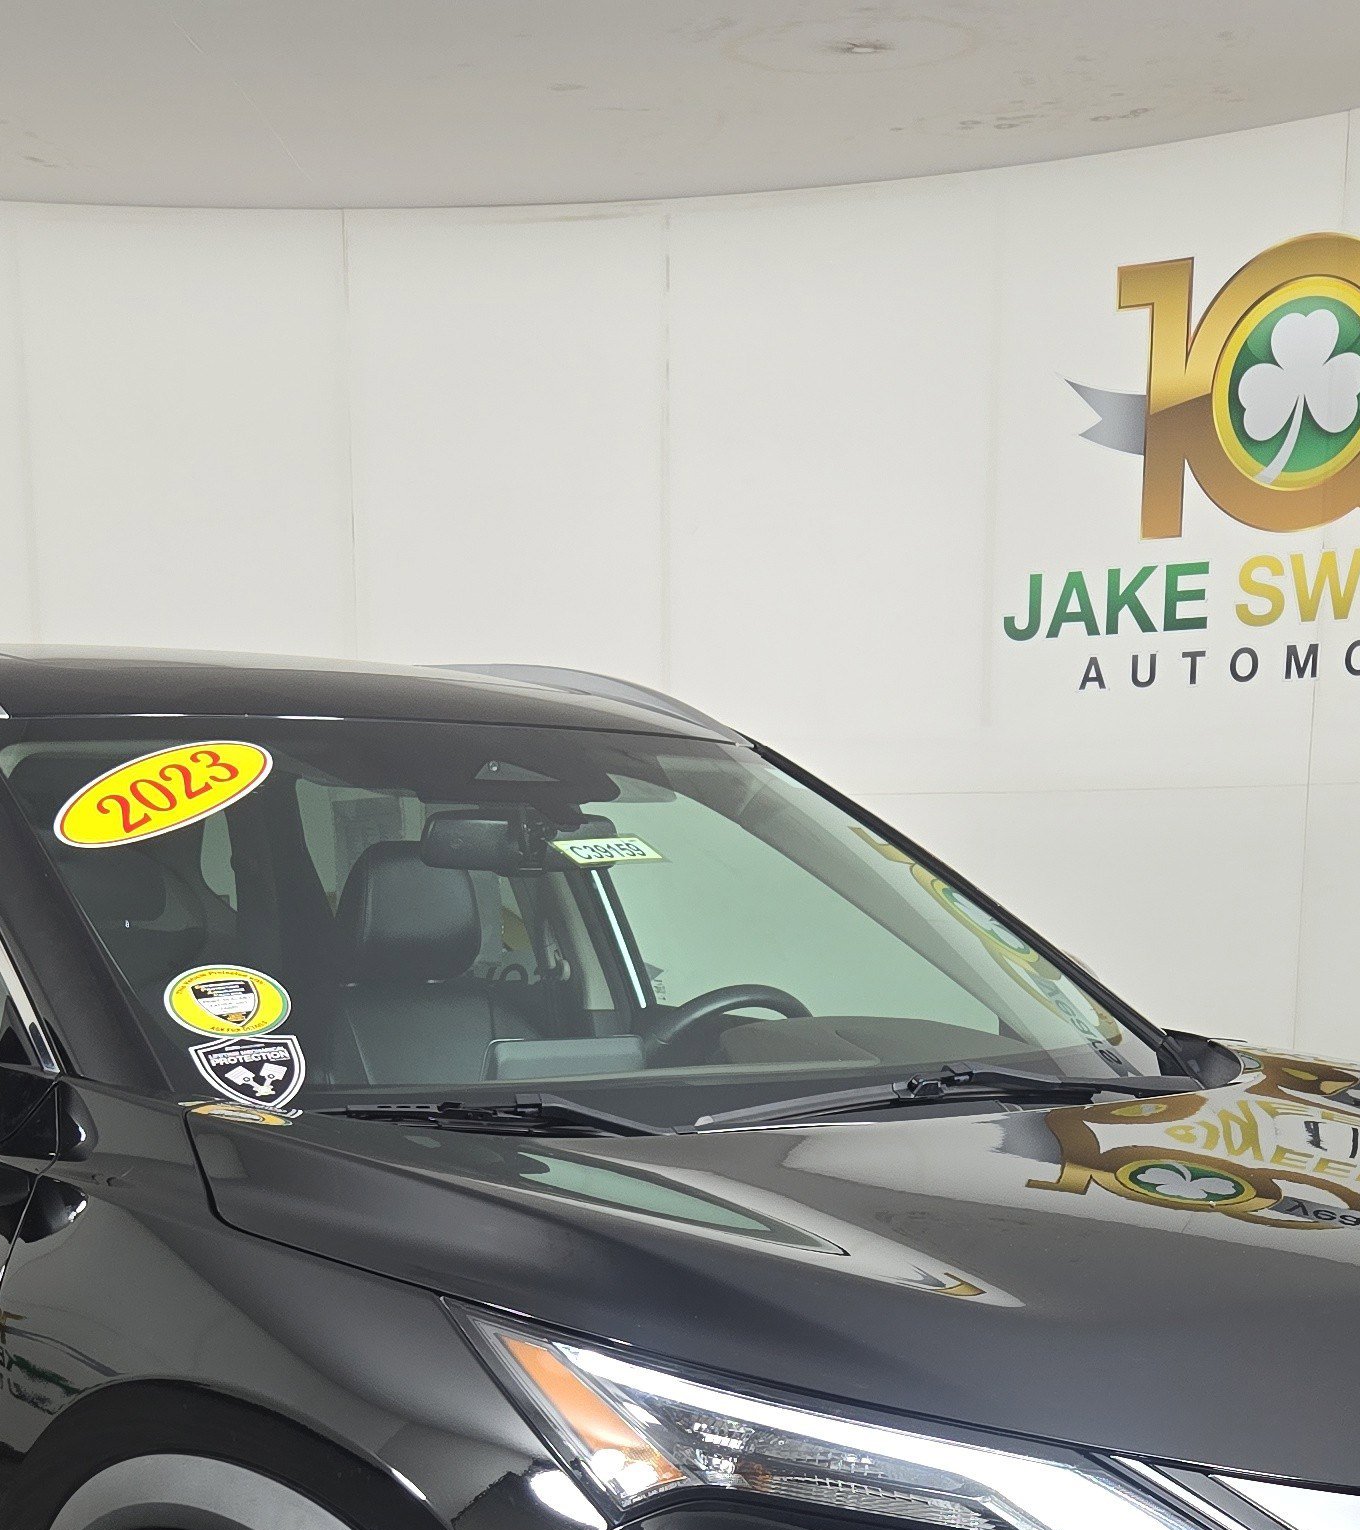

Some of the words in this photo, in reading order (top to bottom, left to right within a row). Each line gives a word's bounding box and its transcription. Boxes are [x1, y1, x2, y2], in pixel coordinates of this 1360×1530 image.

[1003, 561, 1211, 643] JAKE
[96, 750, 240, 834] 2023
[569, 841, 647, 860] C39159
[208, 1049, 291, 1067] PROTECTION
